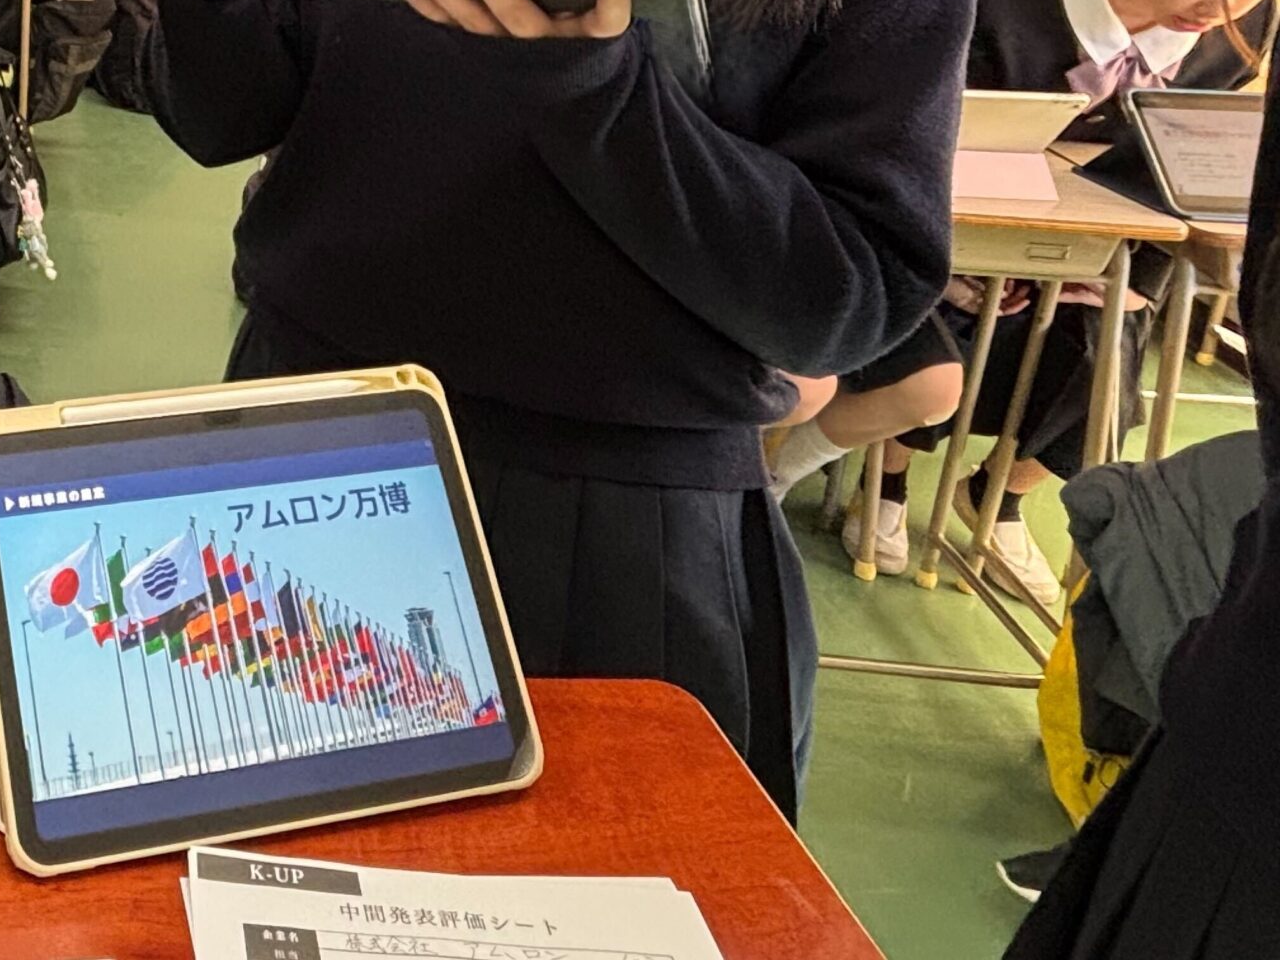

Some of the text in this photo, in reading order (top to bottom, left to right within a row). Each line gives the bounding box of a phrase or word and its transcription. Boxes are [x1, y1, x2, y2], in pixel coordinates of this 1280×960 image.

[227, 480, 411, 533] アムロン万博
[250, 863, 304, 884] K-UP
[339, 902, 558, 936] 中間発表評価シート
